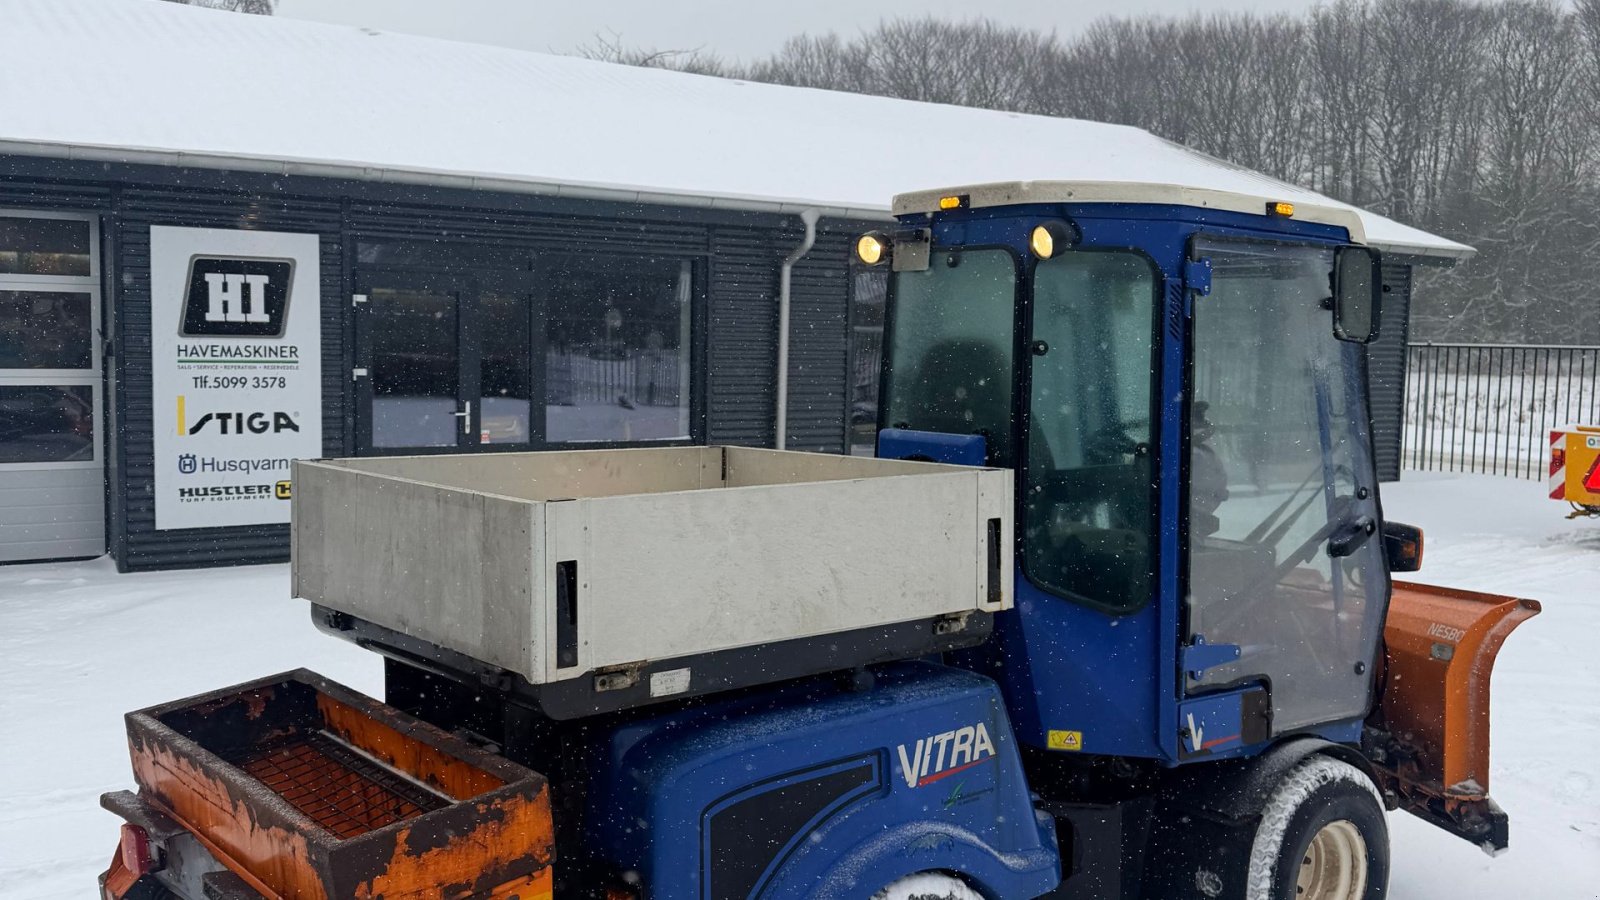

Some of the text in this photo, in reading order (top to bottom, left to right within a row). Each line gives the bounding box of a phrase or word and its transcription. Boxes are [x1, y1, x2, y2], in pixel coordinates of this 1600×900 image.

[204, 273, 270, 323] HI
[177, 344, 299, 358] HAVEMASKINER
[192, 375, 286, 389] Tlf.5099 3578
[189, 412, 300, 435] STIGA
[202, 457, 296, 475] Husqvarn
[179, 484, 271, 498] HUSTLER
[211, 494, 271, 502] EQUIPMENT
[897, 722, 996, 788] VITRA
